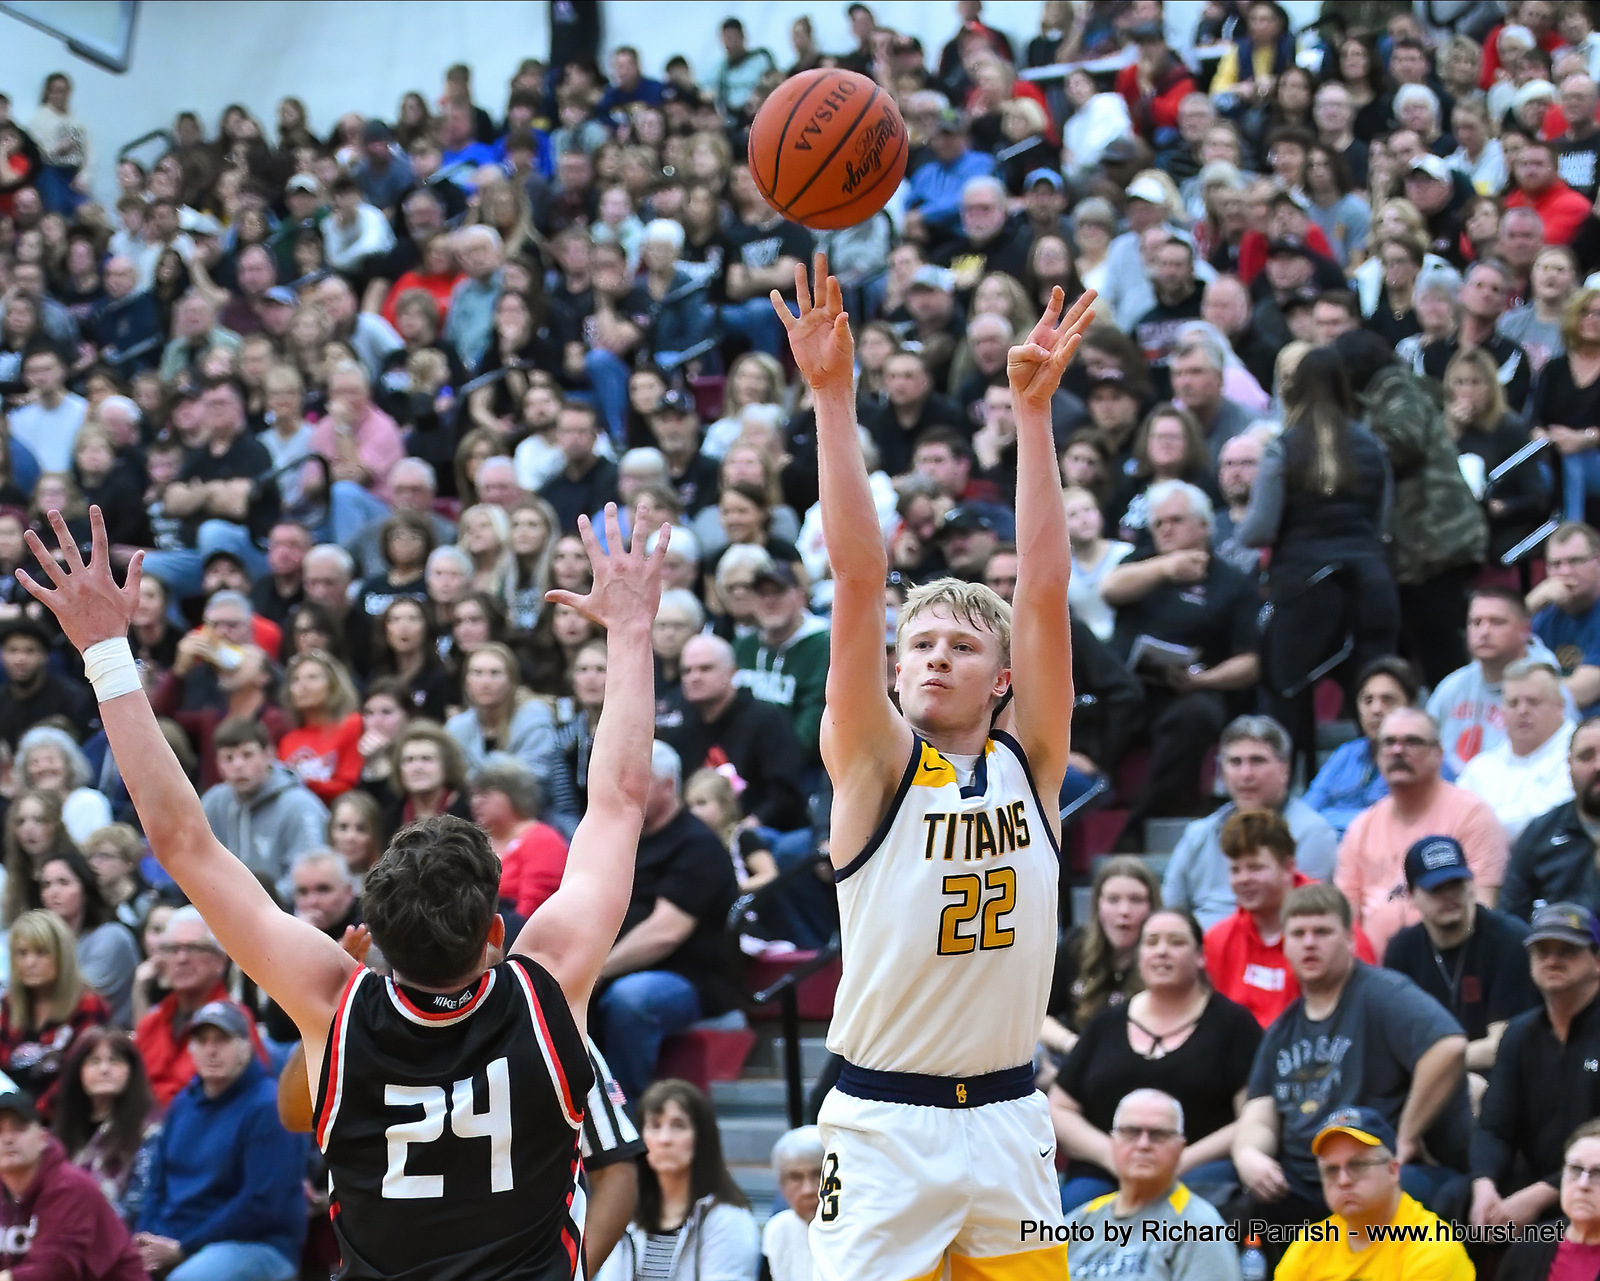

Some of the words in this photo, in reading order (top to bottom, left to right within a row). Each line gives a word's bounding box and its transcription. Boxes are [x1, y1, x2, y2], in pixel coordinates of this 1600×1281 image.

[794, 80, 857, 151] OHSAA
[842, 104, 898, 194] Rawlings
[923, 800, 1031, 861] TITANS
[936, 866, 1016, 956] 22
[433, 995, 457, 1010] NIKE
[382, 1056, 514, 1199] 24
